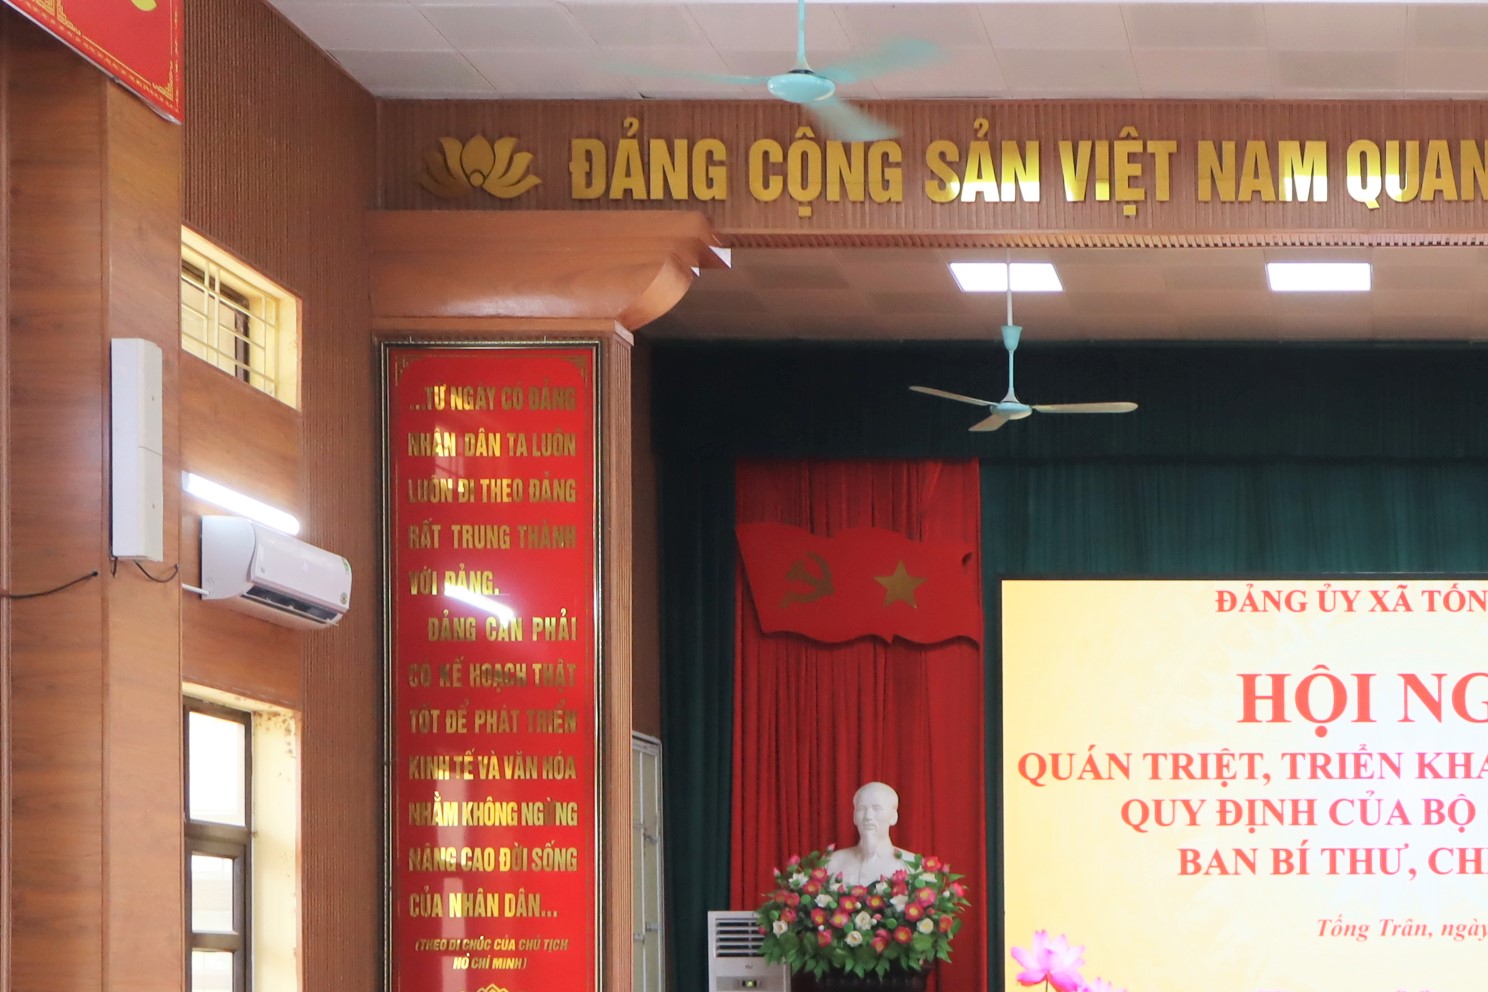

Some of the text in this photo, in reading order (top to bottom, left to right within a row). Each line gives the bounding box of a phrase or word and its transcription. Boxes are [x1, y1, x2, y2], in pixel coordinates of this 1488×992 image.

[569, 118, 727, 202] ĐẢNG
[749, 127, 902, 216] CỘNG
[926, 118, 1041, 203] SẢN
[1059, 127, 1177, 215] VIỆT
[1198, 140, 1327, 202] NAM
[451, 382, 496, 411] NGÀY
[501, 382, 524, 411] CÓ
[528, 378, 576, 411] ĐẢNG
[408, 427, 576, 457] NHÂN DÂN TA LUÔN
[408, 472, 576, 503] LUÔN ĐI THEO ĐẢNG
[408, 518, 576, 549] RẤT TRUNG THÀNH
[409, 566, 438, 596] VỚI
[1215, 583, 1308, 612] ĐẢNG
[1318, 583, 1361, 612] ỦY
[1369, 584, 1413, 612] XÃ
[428, 610, 476, 641] ĐẢNG
[532, 608, 577, 641] PHẢI
[439, 657, 462, 687] KẾ
[470, 664, 526, 692] HOẠCH
[532, 658, 576, 693] THẬT
[409, 699, 577, 734] TỐT ĐỂ PHÁT TRIỂN
[1236, 664, 1377, 737] HỘI
[409, 749, 576, 780] KINH TẾ VÀ VĂN HÓA
[1018, 744, 1132, 786] QUÁN
[1143, 748, 1271, 787] TRIỆT,
[1281, 744, 1402, 780] TRIỂN
[409, 791, 578, 826] NHẰM KHÔNG NGỪNG
[1121, 798, 1206, 833] QUY
[1216, 798, 1317, 834] ĐỊNH
[1329, 790, 1411, 826] CỦA
[1422, 794, 1475, 833] BỘ
[409, 840, 578, 871] NÂNG CAO ĐỜI SỐNG
[1177, 848, 1257, 876] BAN
[1270, 840, 1310, 875] BÍ
[1321, 843, 1417, 881] THƯ,
[410, 885, 558, 918] CỦA NHÂN DÂN...
[462, 936, 492, 951] CHÚC
[493, 935, 516, 951] CỦA
[1378, 918, 1433, 938] Trân,
[471, 955, 490, 969] CHÍ
